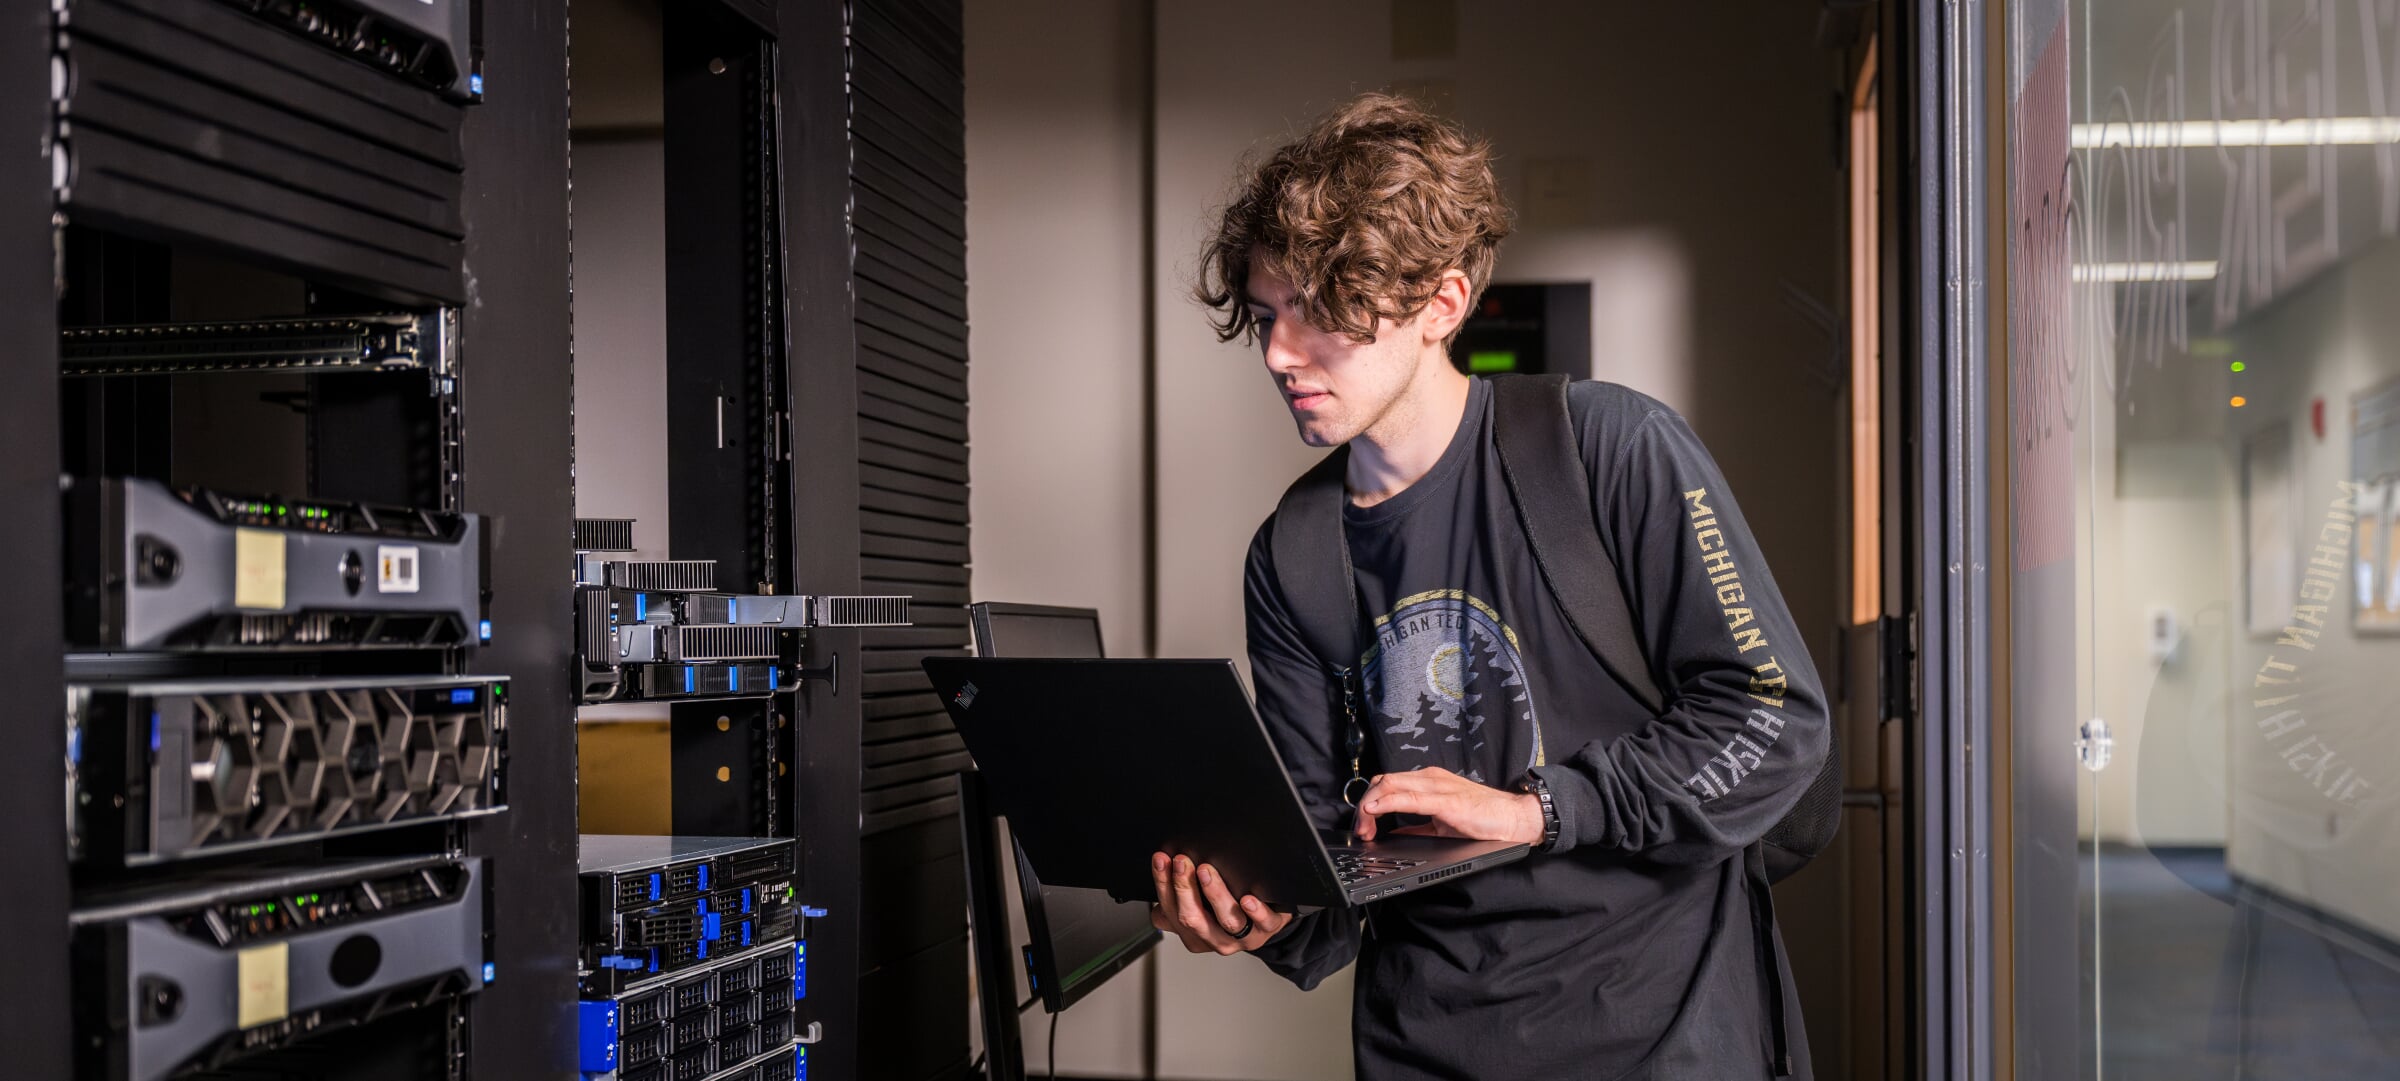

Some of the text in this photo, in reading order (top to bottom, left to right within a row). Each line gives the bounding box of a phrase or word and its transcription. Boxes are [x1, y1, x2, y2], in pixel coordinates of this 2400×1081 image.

[1380, 613, 1465, 655] HIGAN TEC
[1683, 487, 1787, 803] MICHIGAN TE HUSKIE
